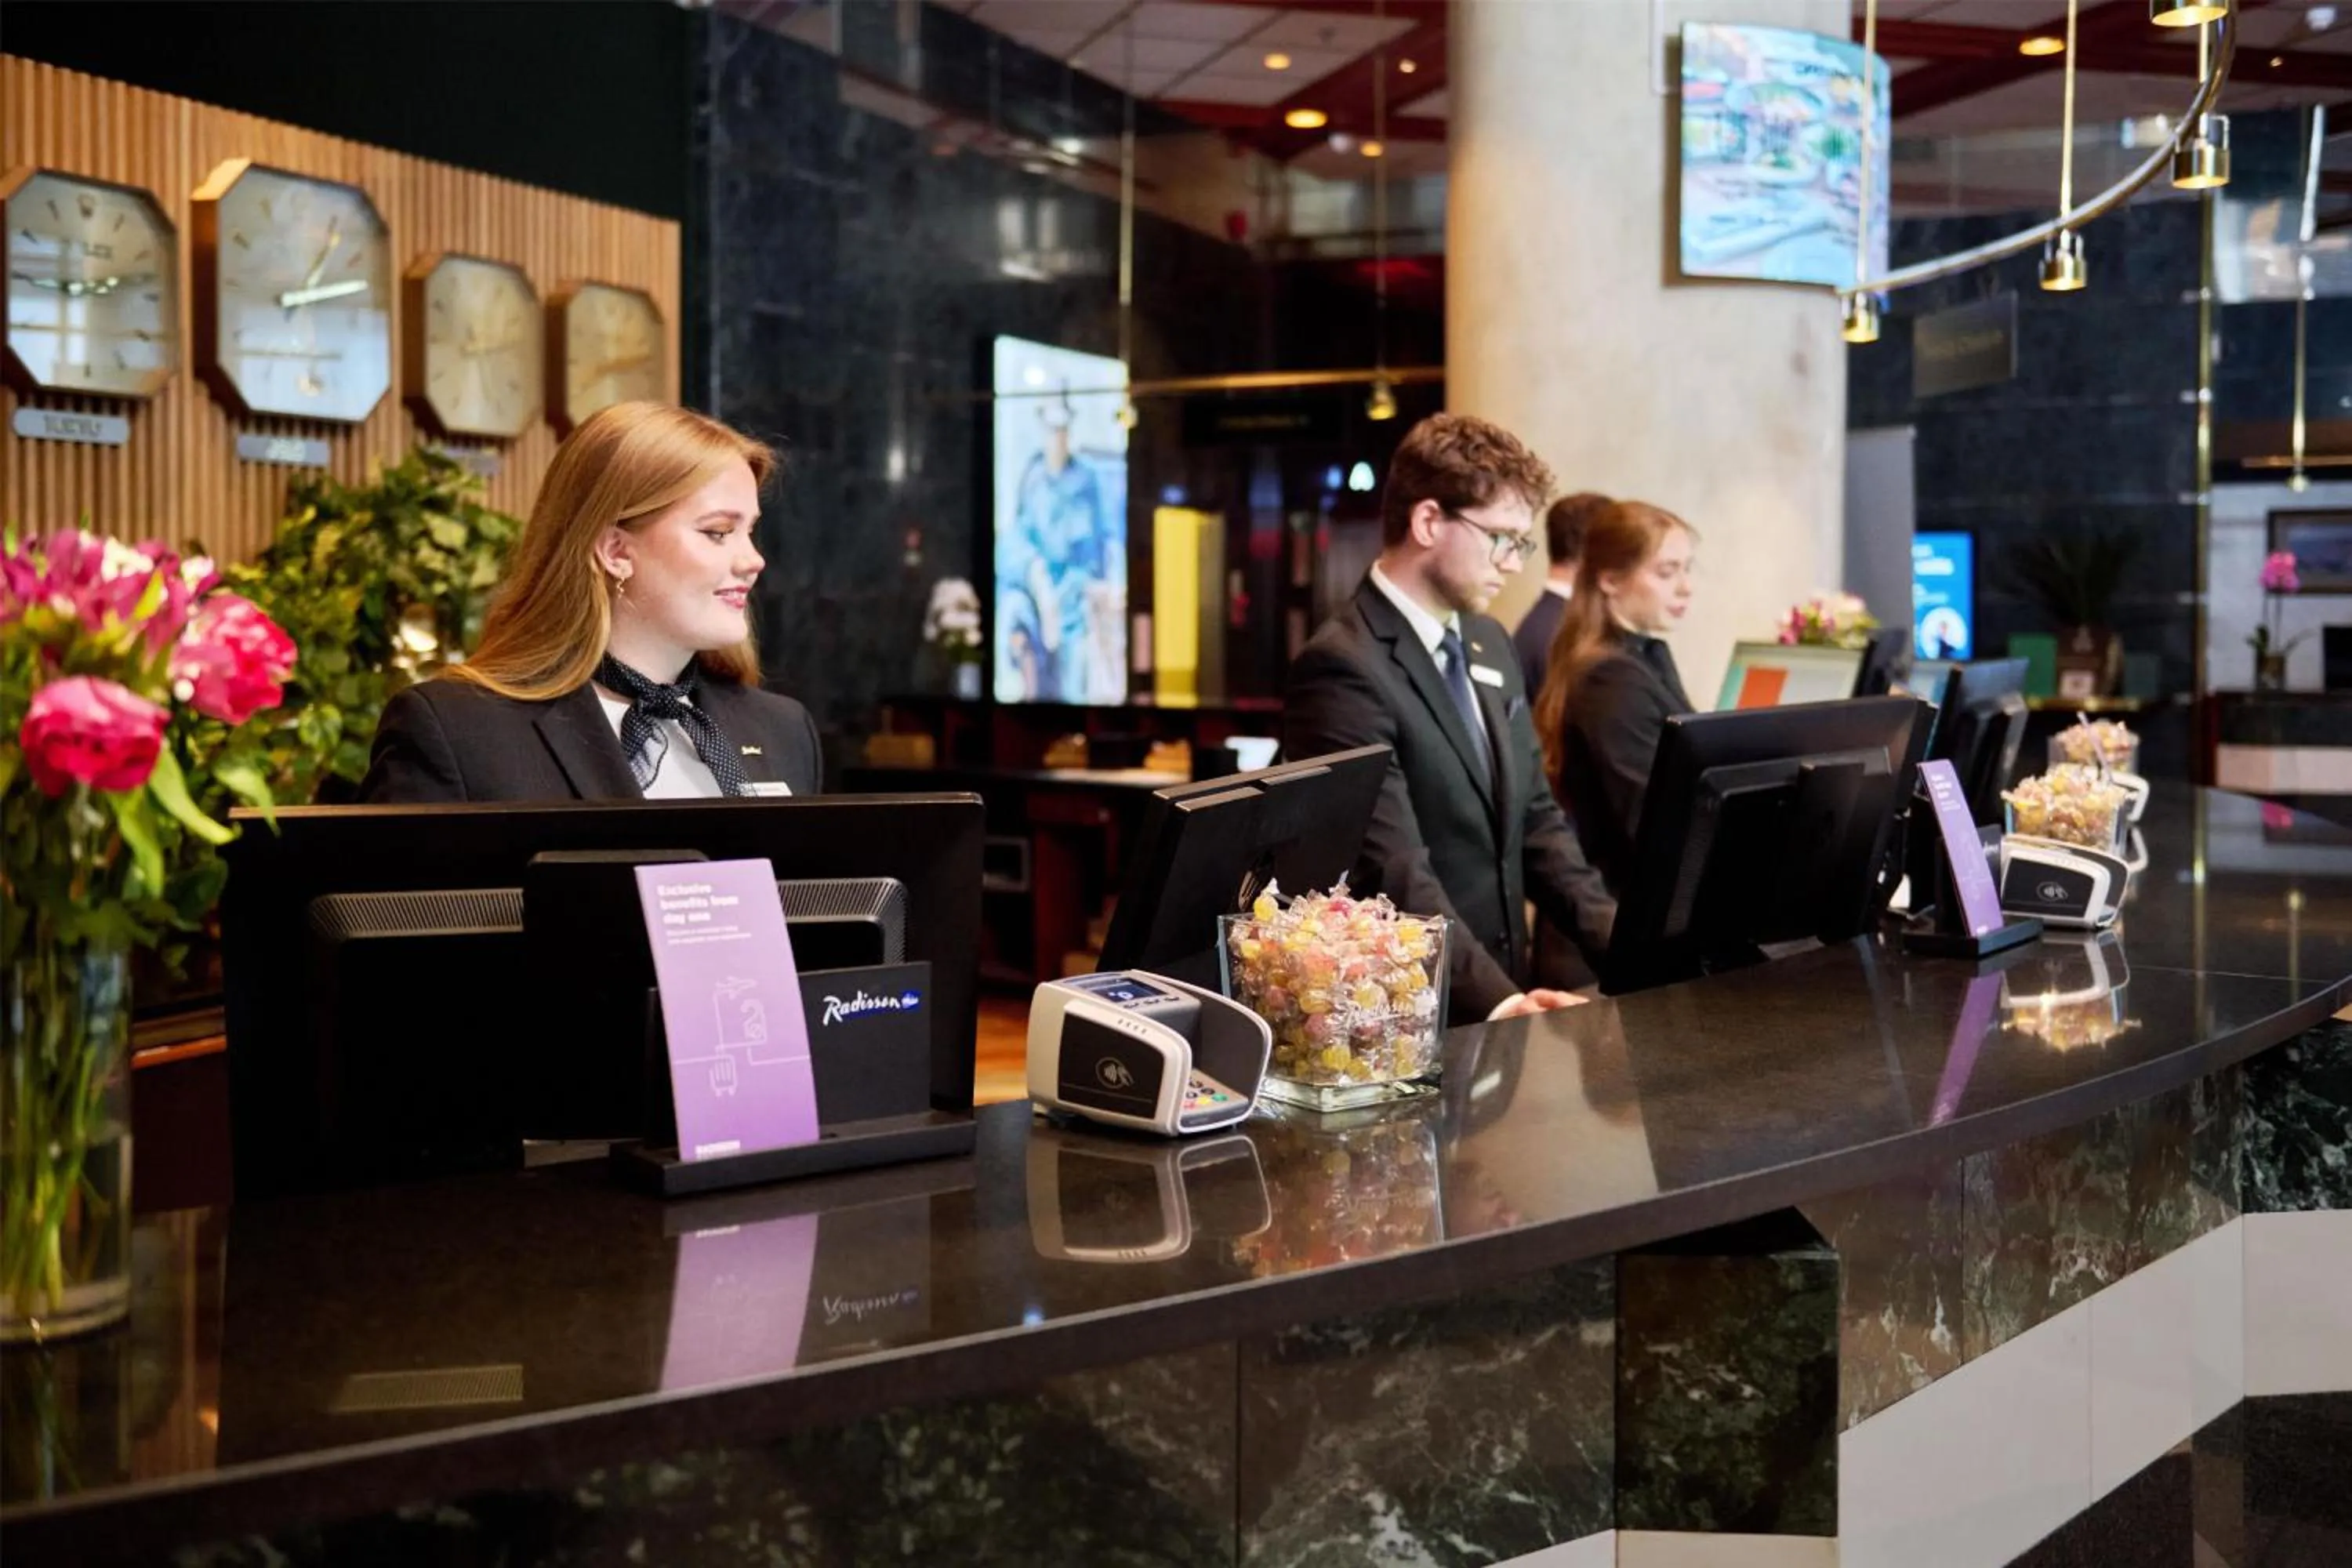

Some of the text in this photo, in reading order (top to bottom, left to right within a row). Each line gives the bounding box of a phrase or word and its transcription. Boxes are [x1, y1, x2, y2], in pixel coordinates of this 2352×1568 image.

[657, 883, 712, 897] Exclusive
[660, 895, 739, 910] benefits from
[663, 912, 711, 925] day one
[822, 989, 901, 1026] Radisson
